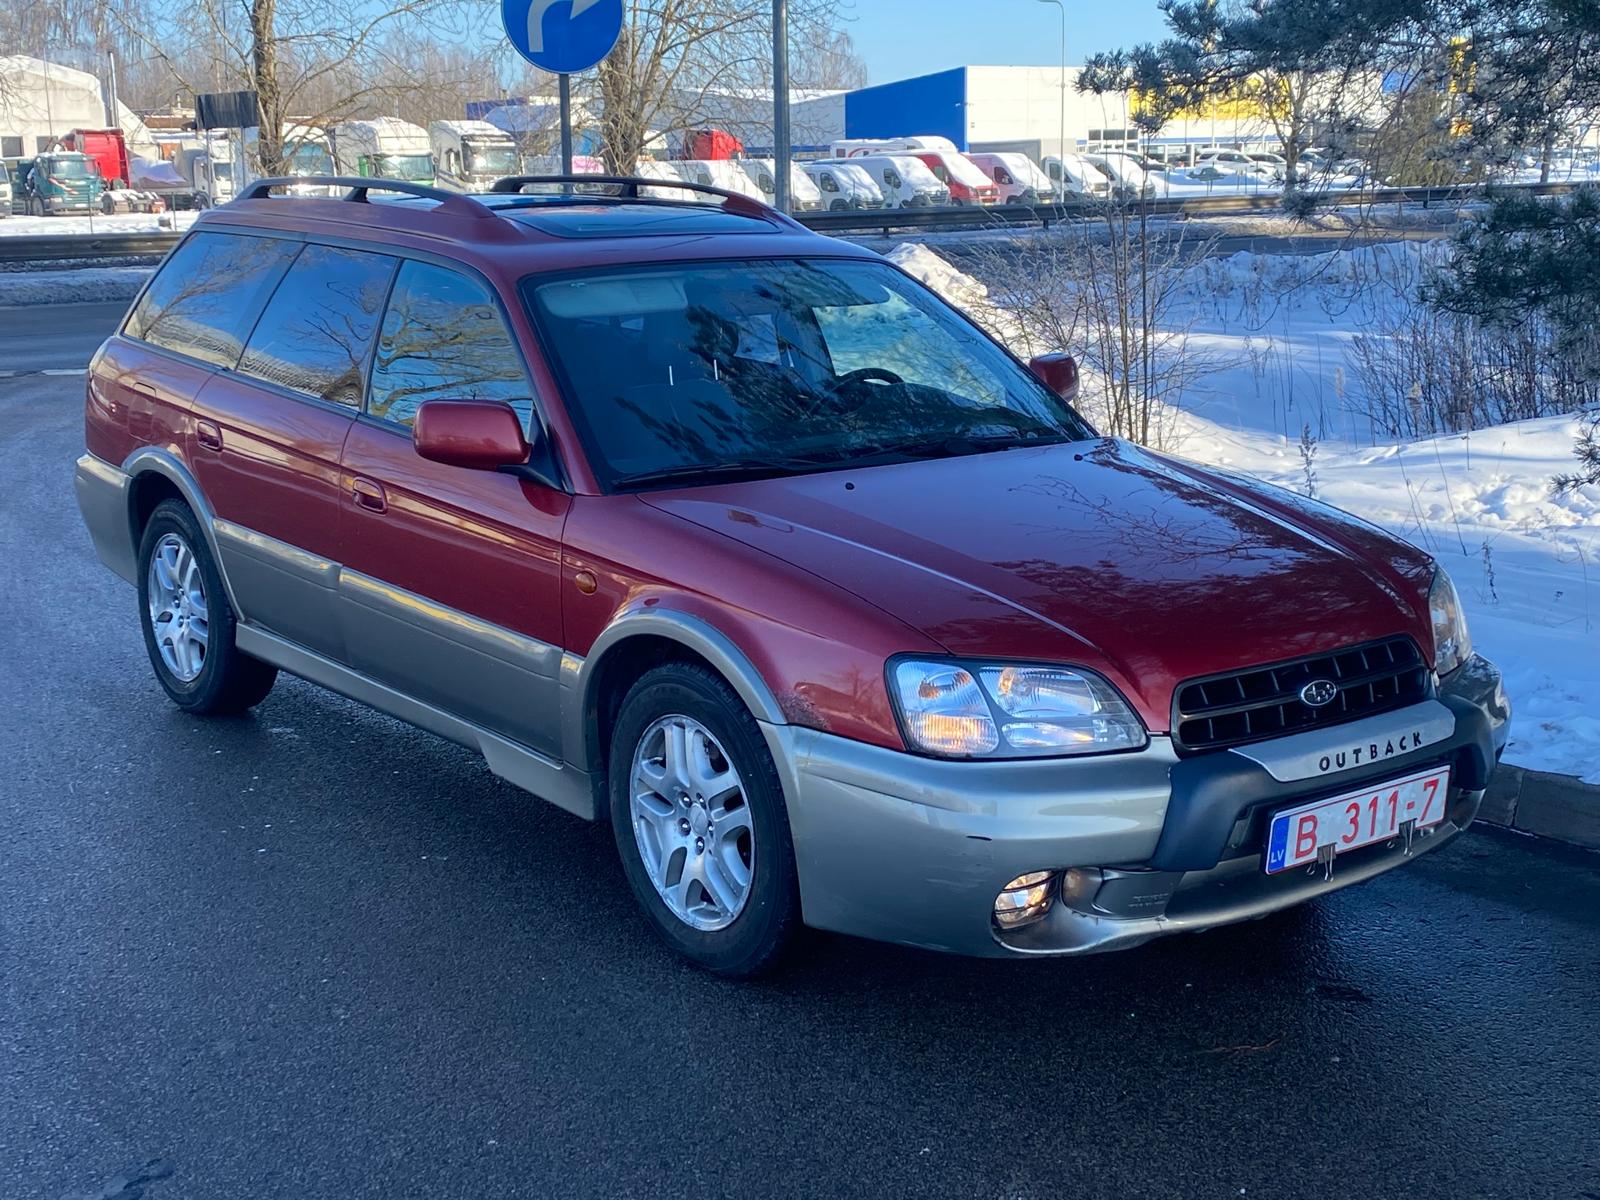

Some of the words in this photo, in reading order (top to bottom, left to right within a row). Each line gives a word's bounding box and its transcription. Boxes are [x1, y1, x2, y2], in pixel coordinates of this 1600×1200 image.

[1319, 731, 1422, 772] OUTBACK
[1294, 814, 1318, 860] B
[1342, 778, 1440, 844] 311-7
[1270, 848, 1285, 864] LV
